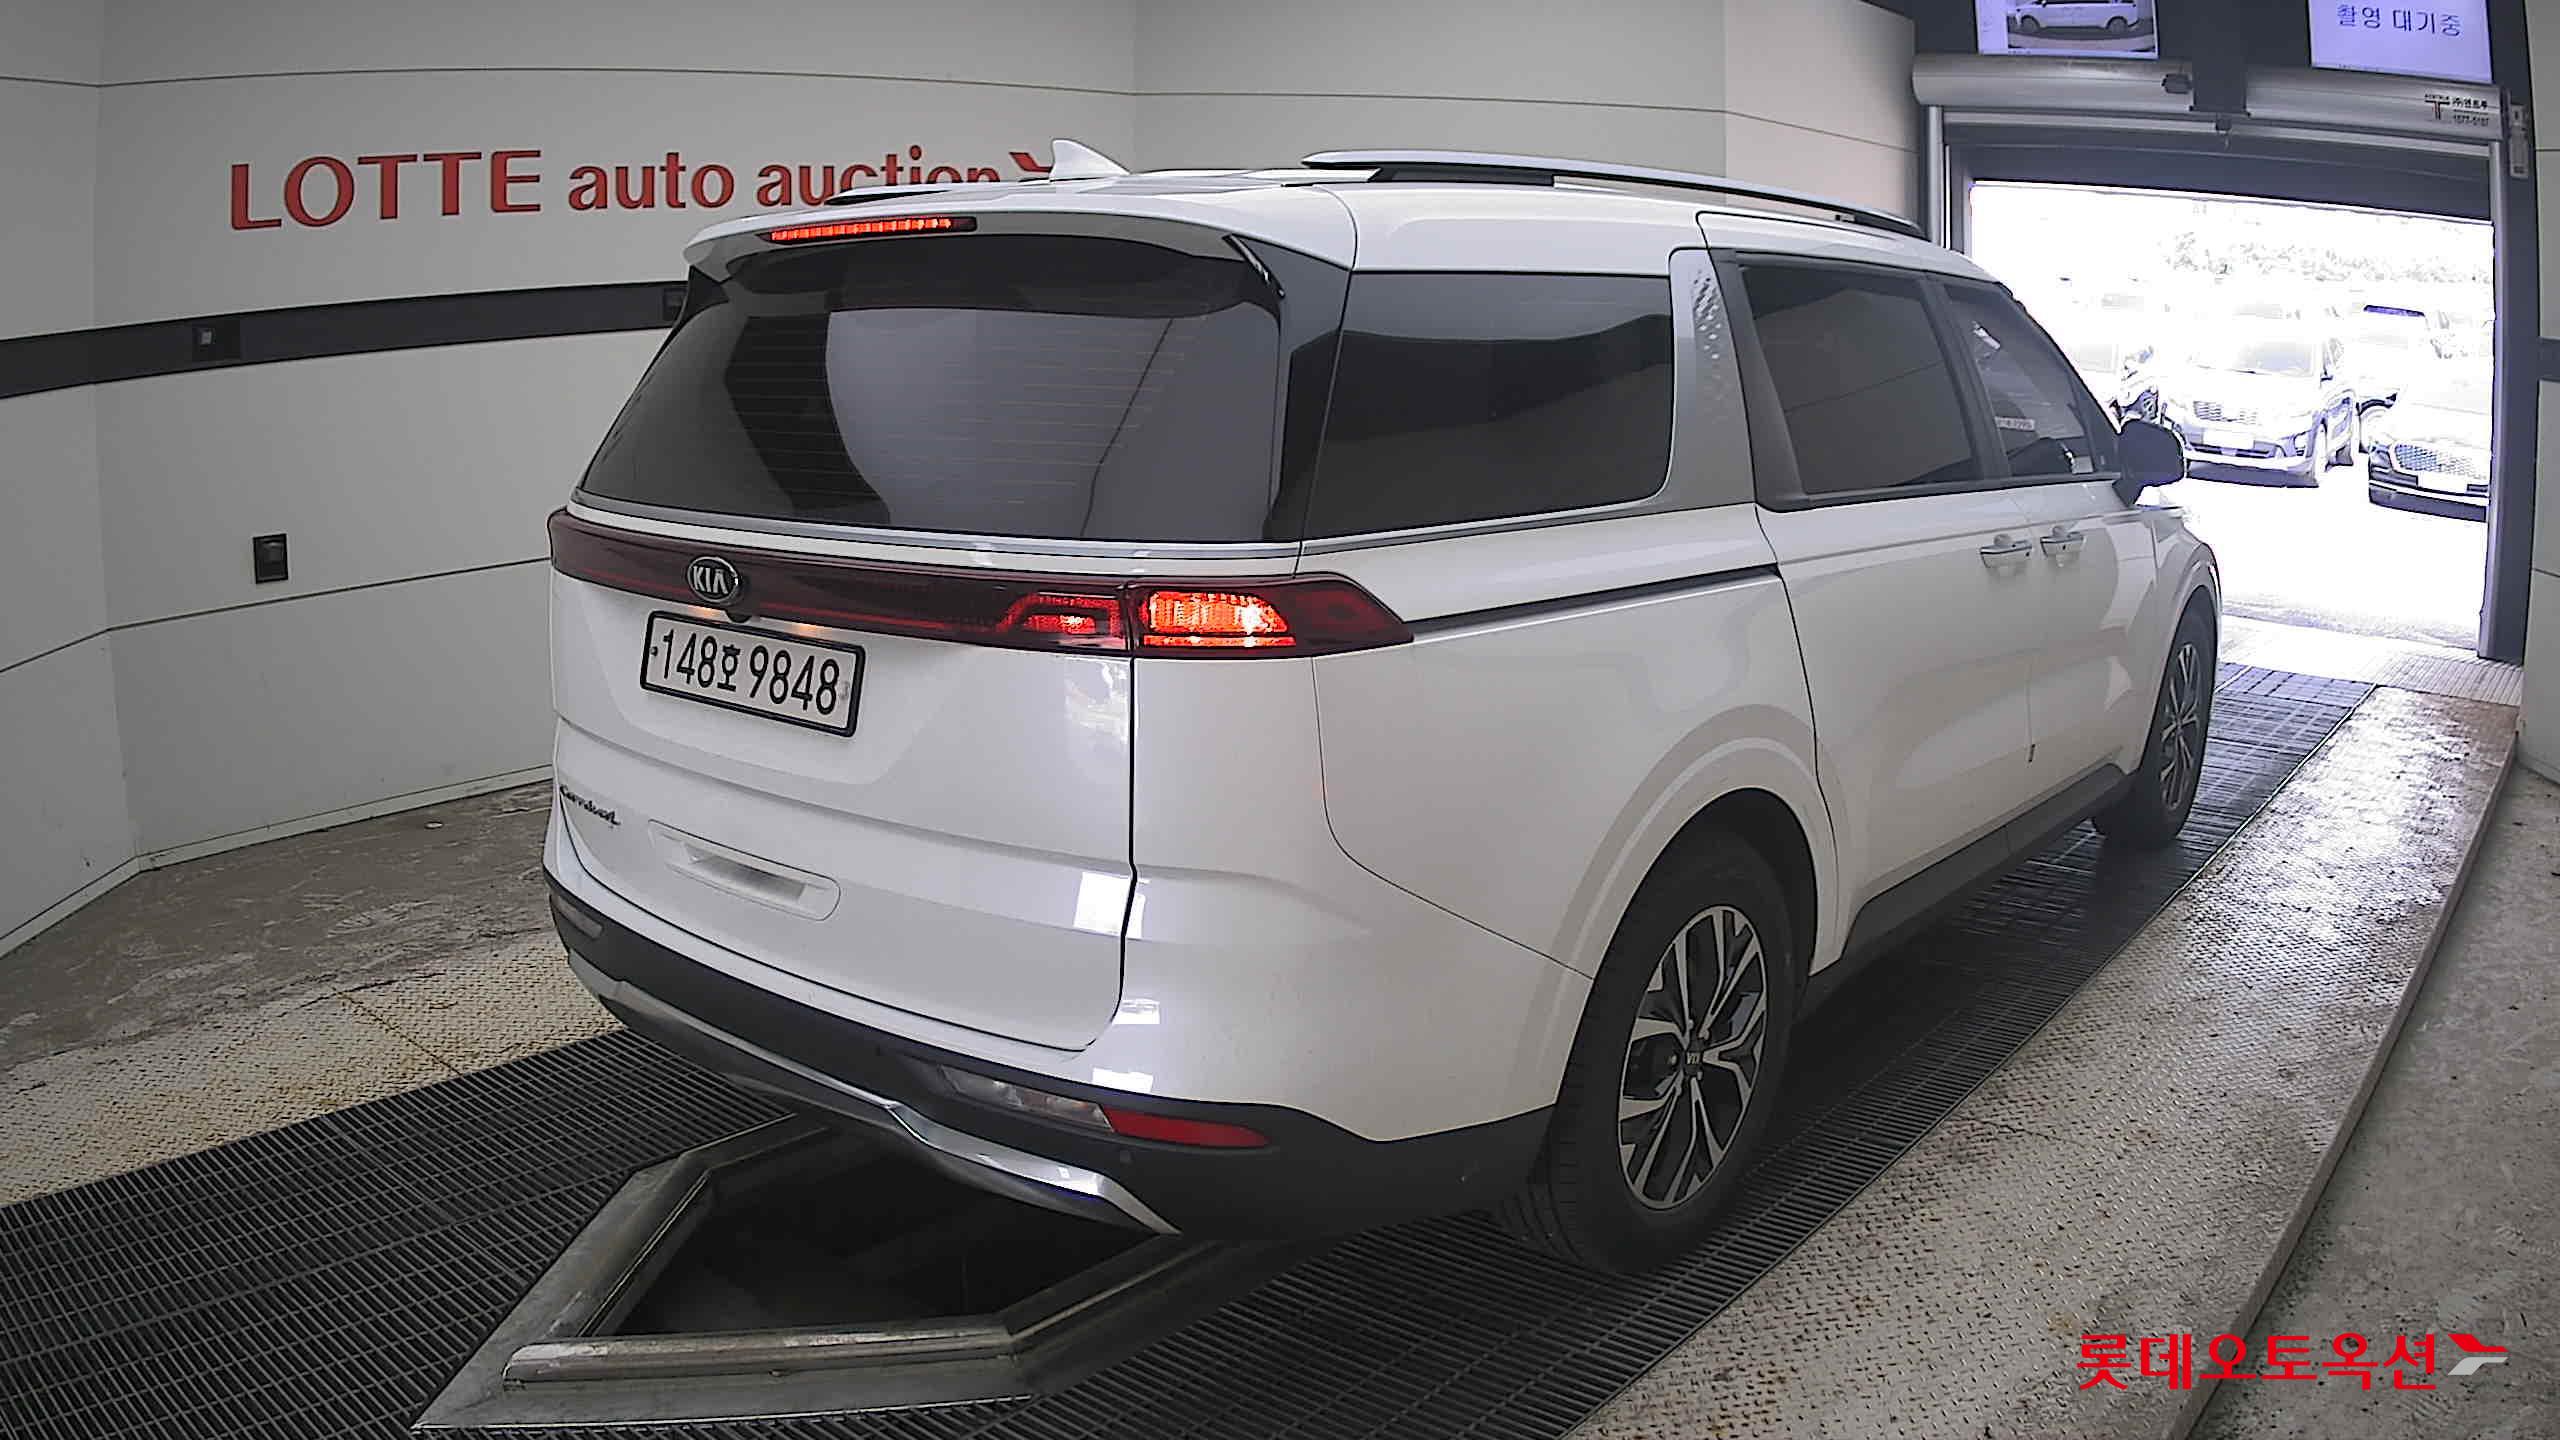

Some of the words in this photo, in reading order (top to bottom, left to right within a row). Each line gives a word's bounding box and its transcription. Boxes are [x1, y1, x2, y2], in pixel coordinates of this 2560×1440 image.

[2337, 4, 2382, 29] 촬영
[2392, 9, 2461, 37] 대기중
[230, 149, 542, 231] LOTTE
[567, 151, 735, 211] auto
[692, 564, 730, 595] KIA
